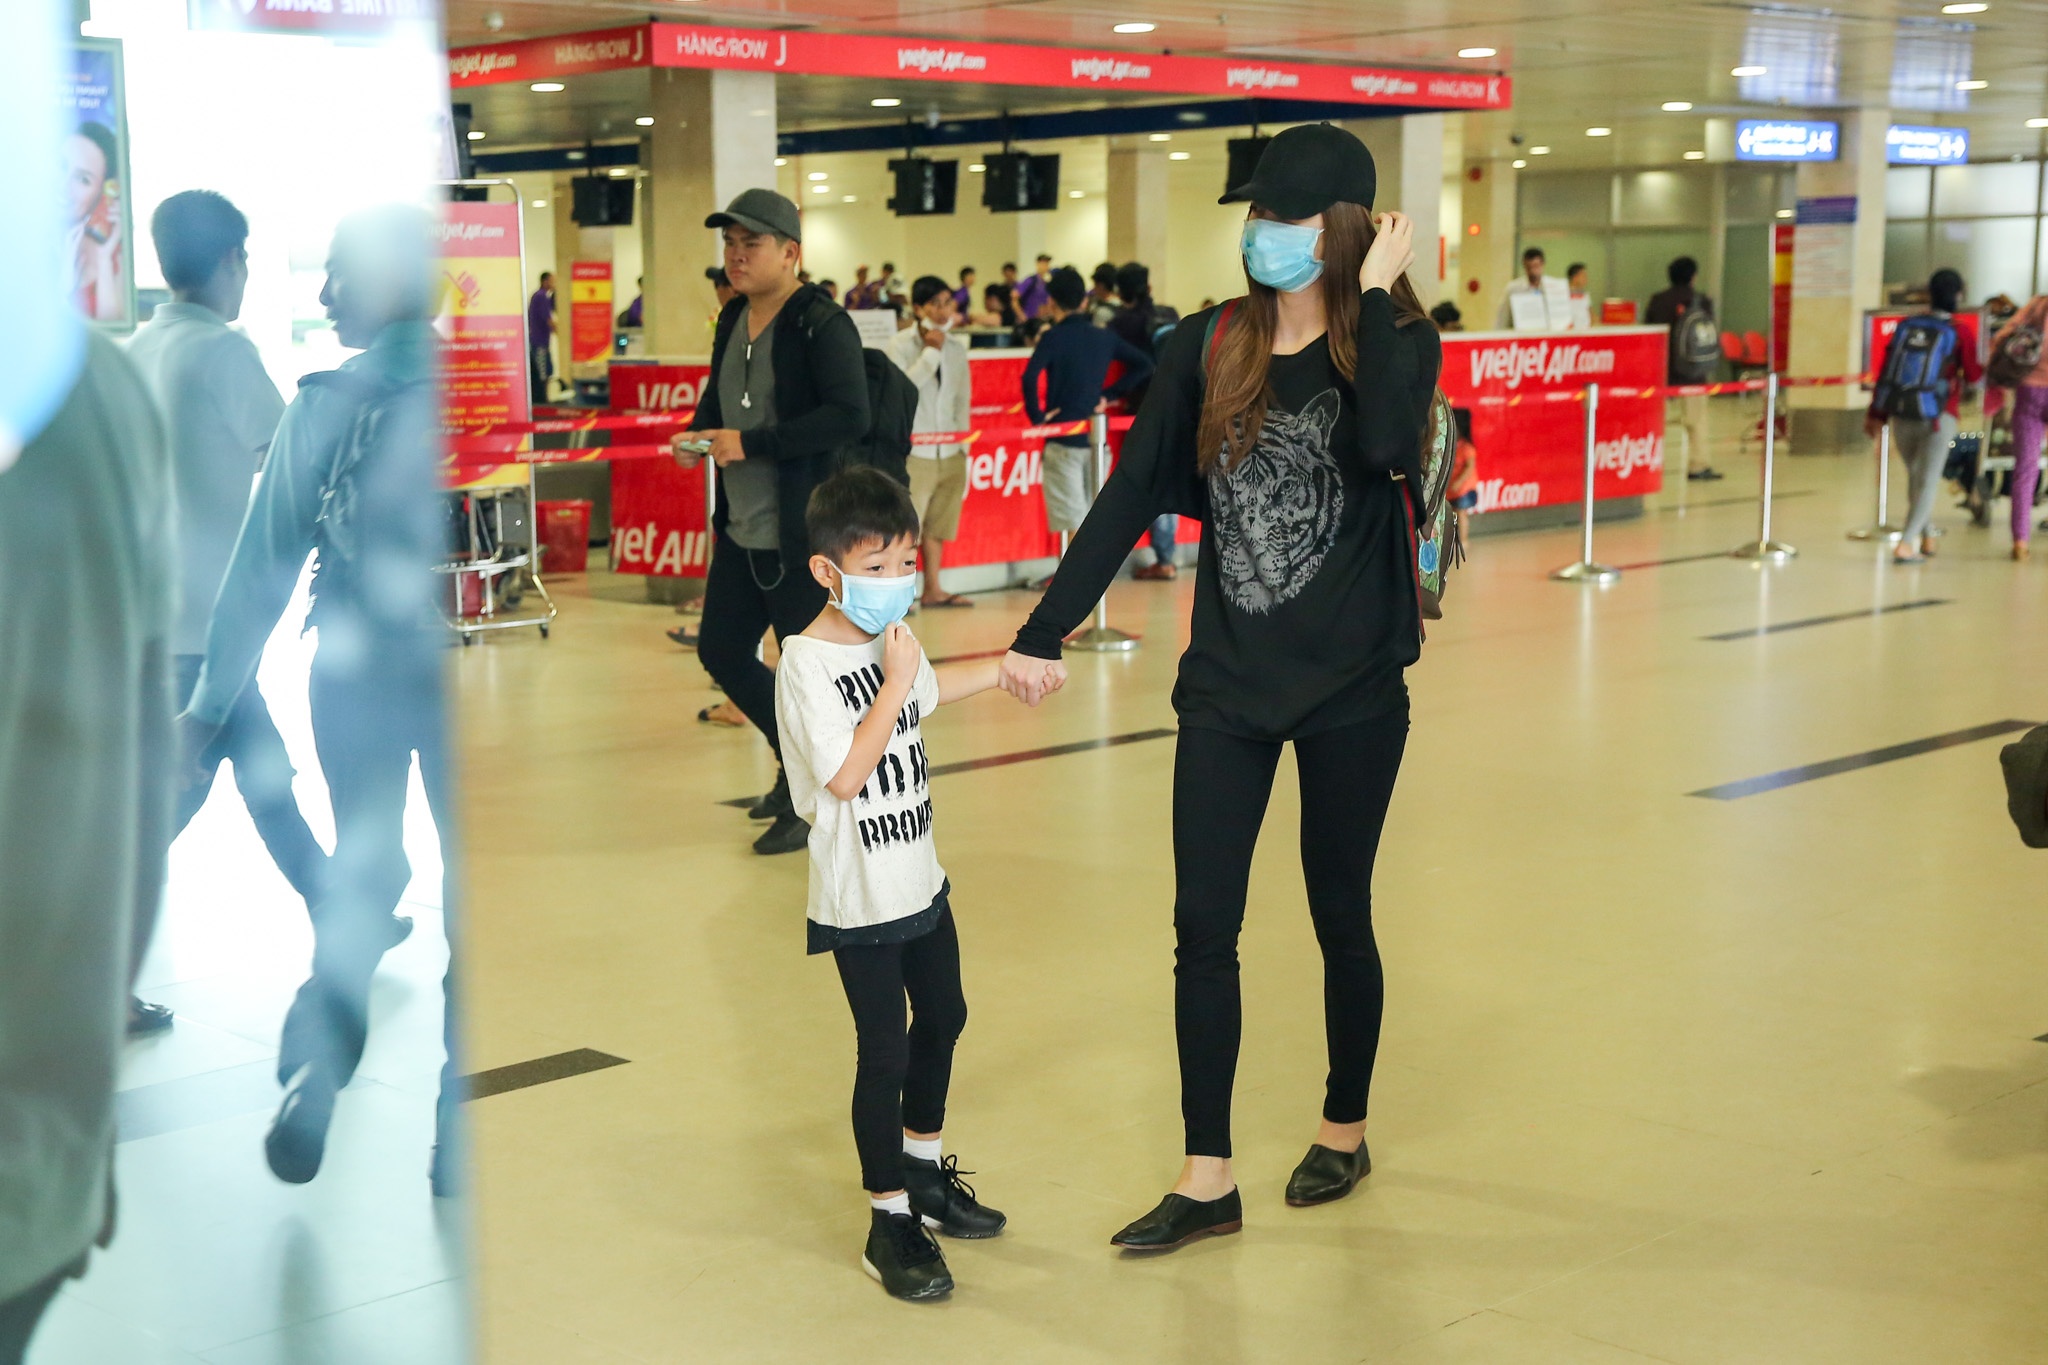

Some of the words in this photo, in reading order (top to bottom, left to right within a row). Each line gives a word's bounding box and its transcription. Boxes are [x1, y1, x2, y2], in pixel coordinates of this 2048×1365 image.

[632, 30, 644, 62] J
[774, 34, 787, 67] J
[1487, 78, 1501, 104] K
